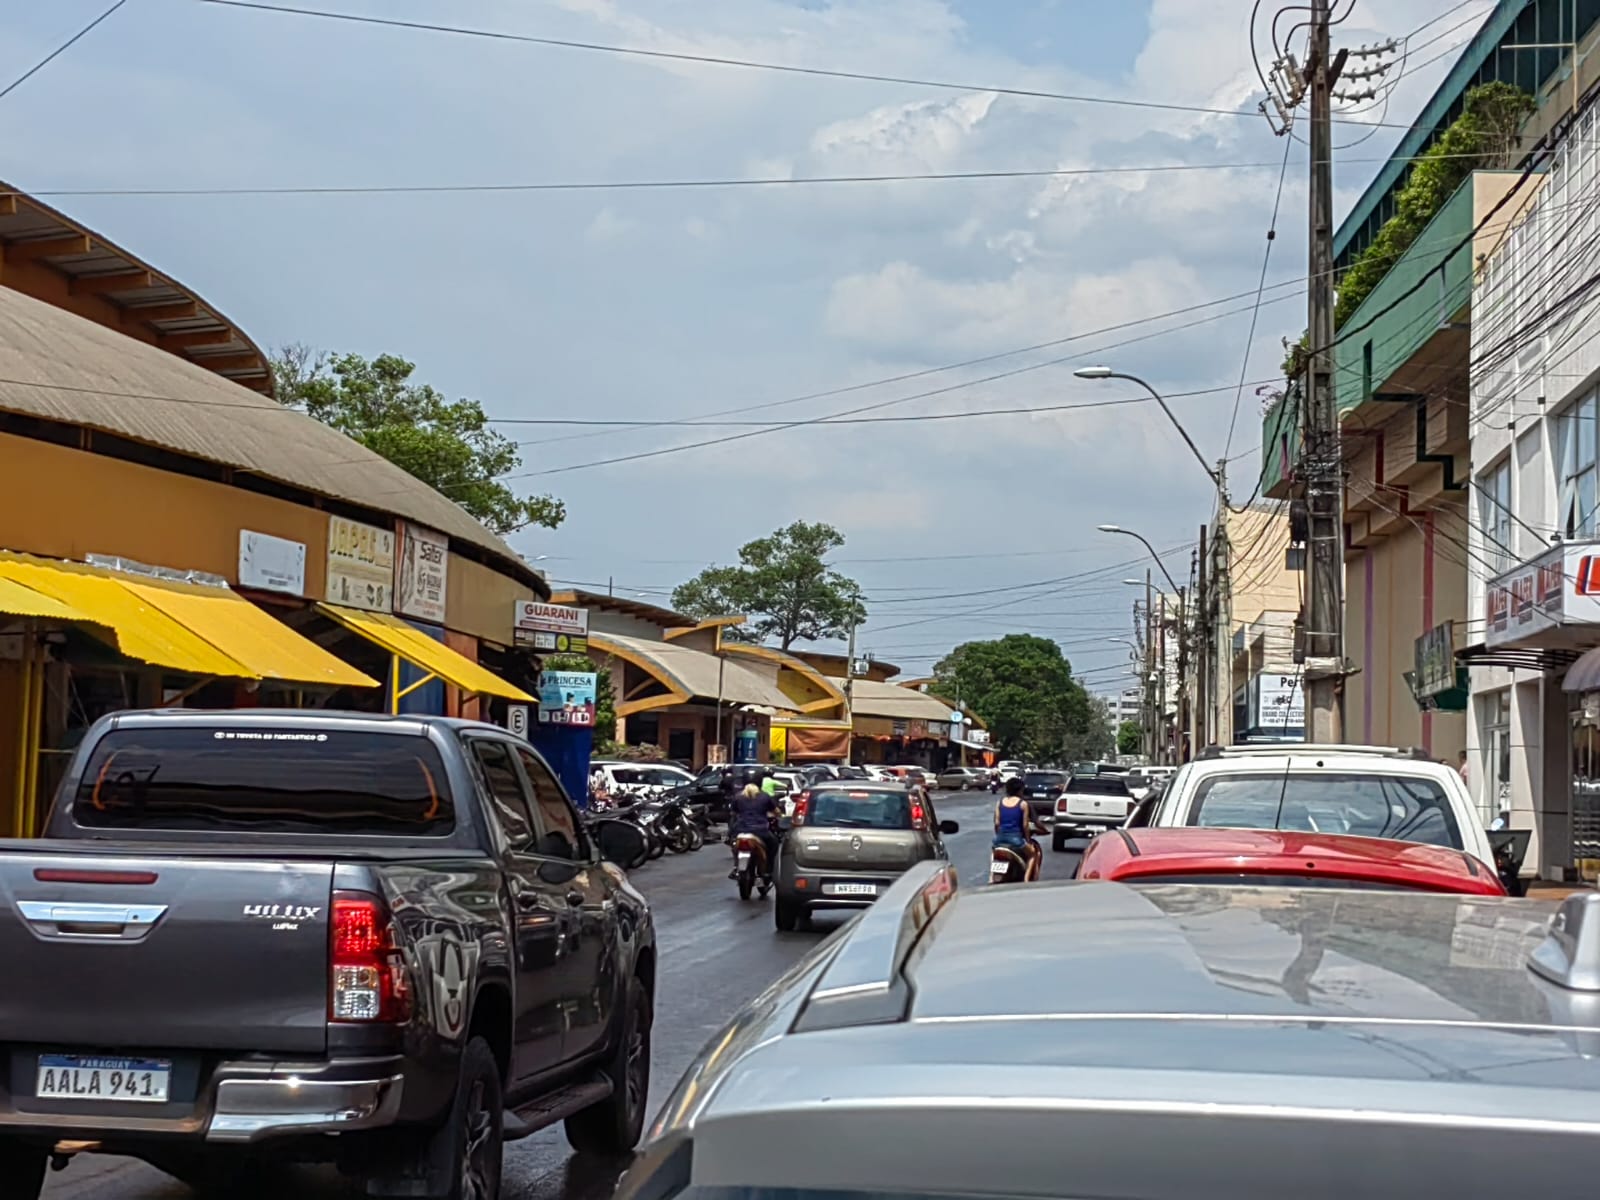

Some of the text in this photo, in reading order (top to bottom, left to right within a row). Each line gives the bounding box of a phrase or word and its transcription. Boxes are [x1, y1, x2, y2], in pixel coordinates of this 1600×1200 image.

[525, 603, 579, 621] GUARANI
[548, 675, 592, 687] PRINCESA
[514, 714, 523, 729] E
[80, 1059, 131, 1070] PARAGUAY
[42, 1068, 153, 1096] AALA 941
